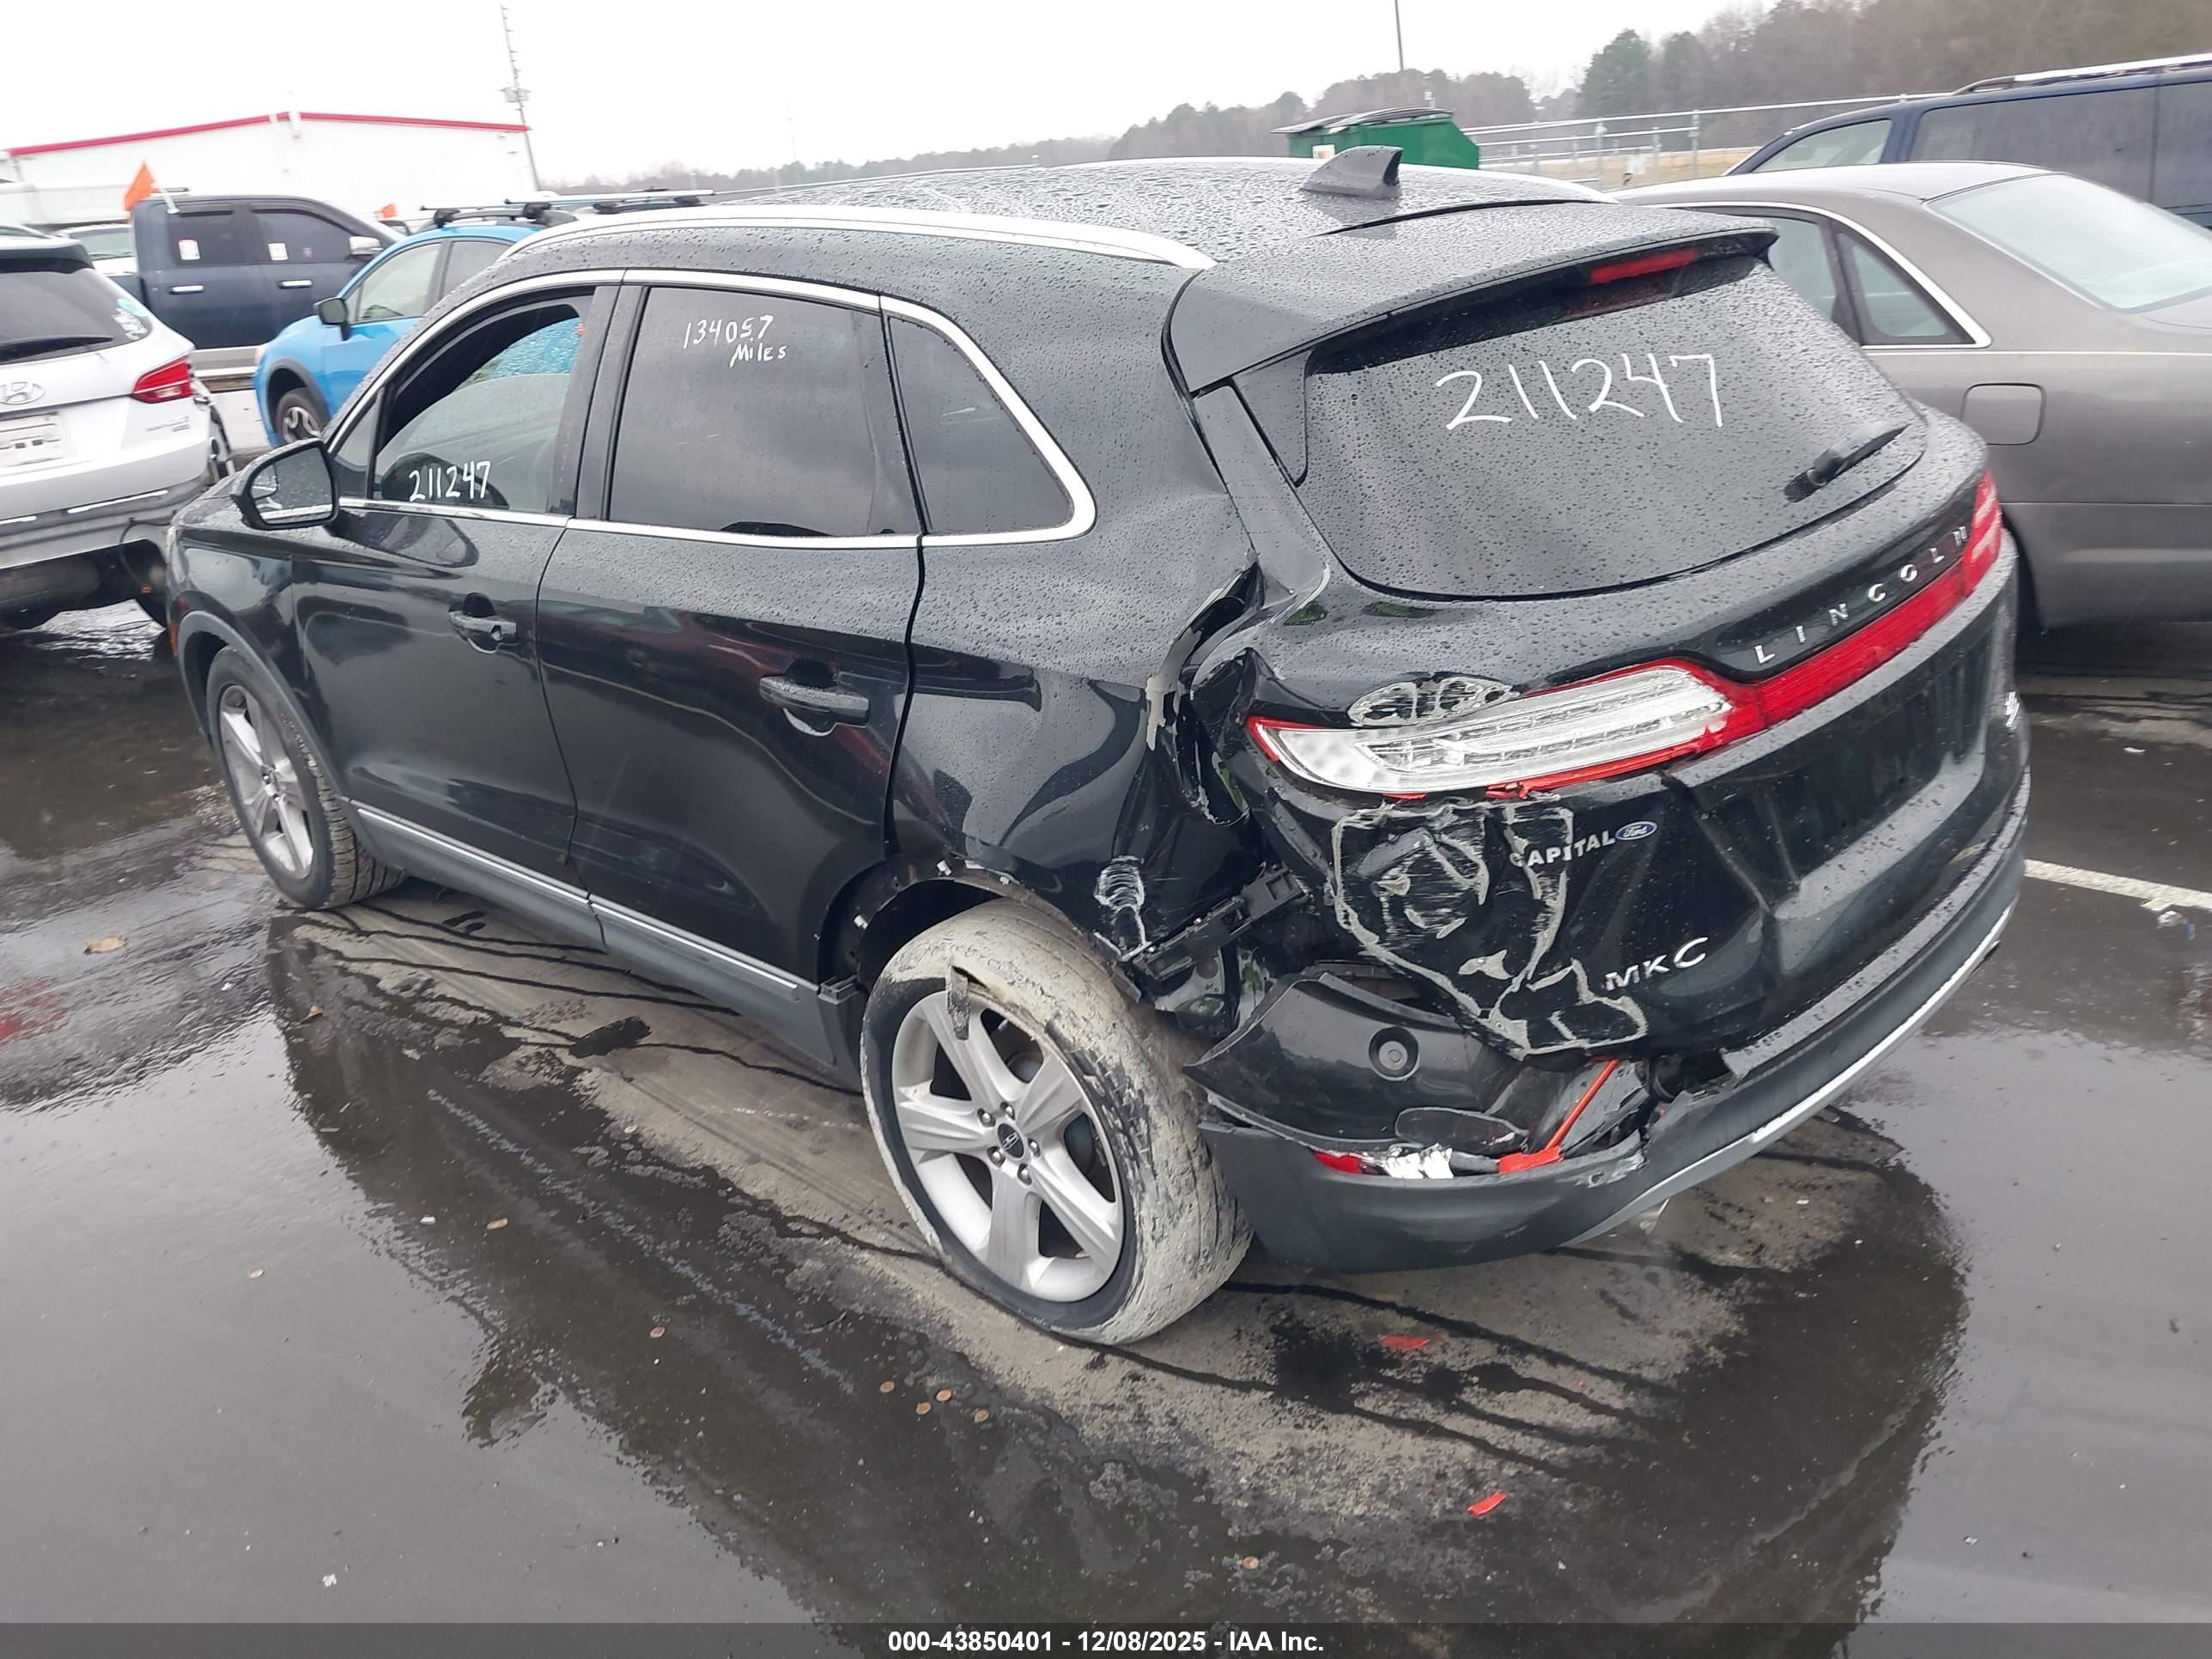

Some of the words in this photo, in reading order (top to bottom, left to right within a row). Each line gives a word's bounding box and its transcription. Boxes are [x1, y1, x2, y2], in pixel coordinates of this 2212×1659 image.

[1436, 352, 1723, 430] 211247
[408, 460, 491, 502] 211247
[1753, 526, 1968, 665] LINCOLN
[1509, 830, 1616, 867] CAPITAL
[1605, 937, 1709, 991] MKC
